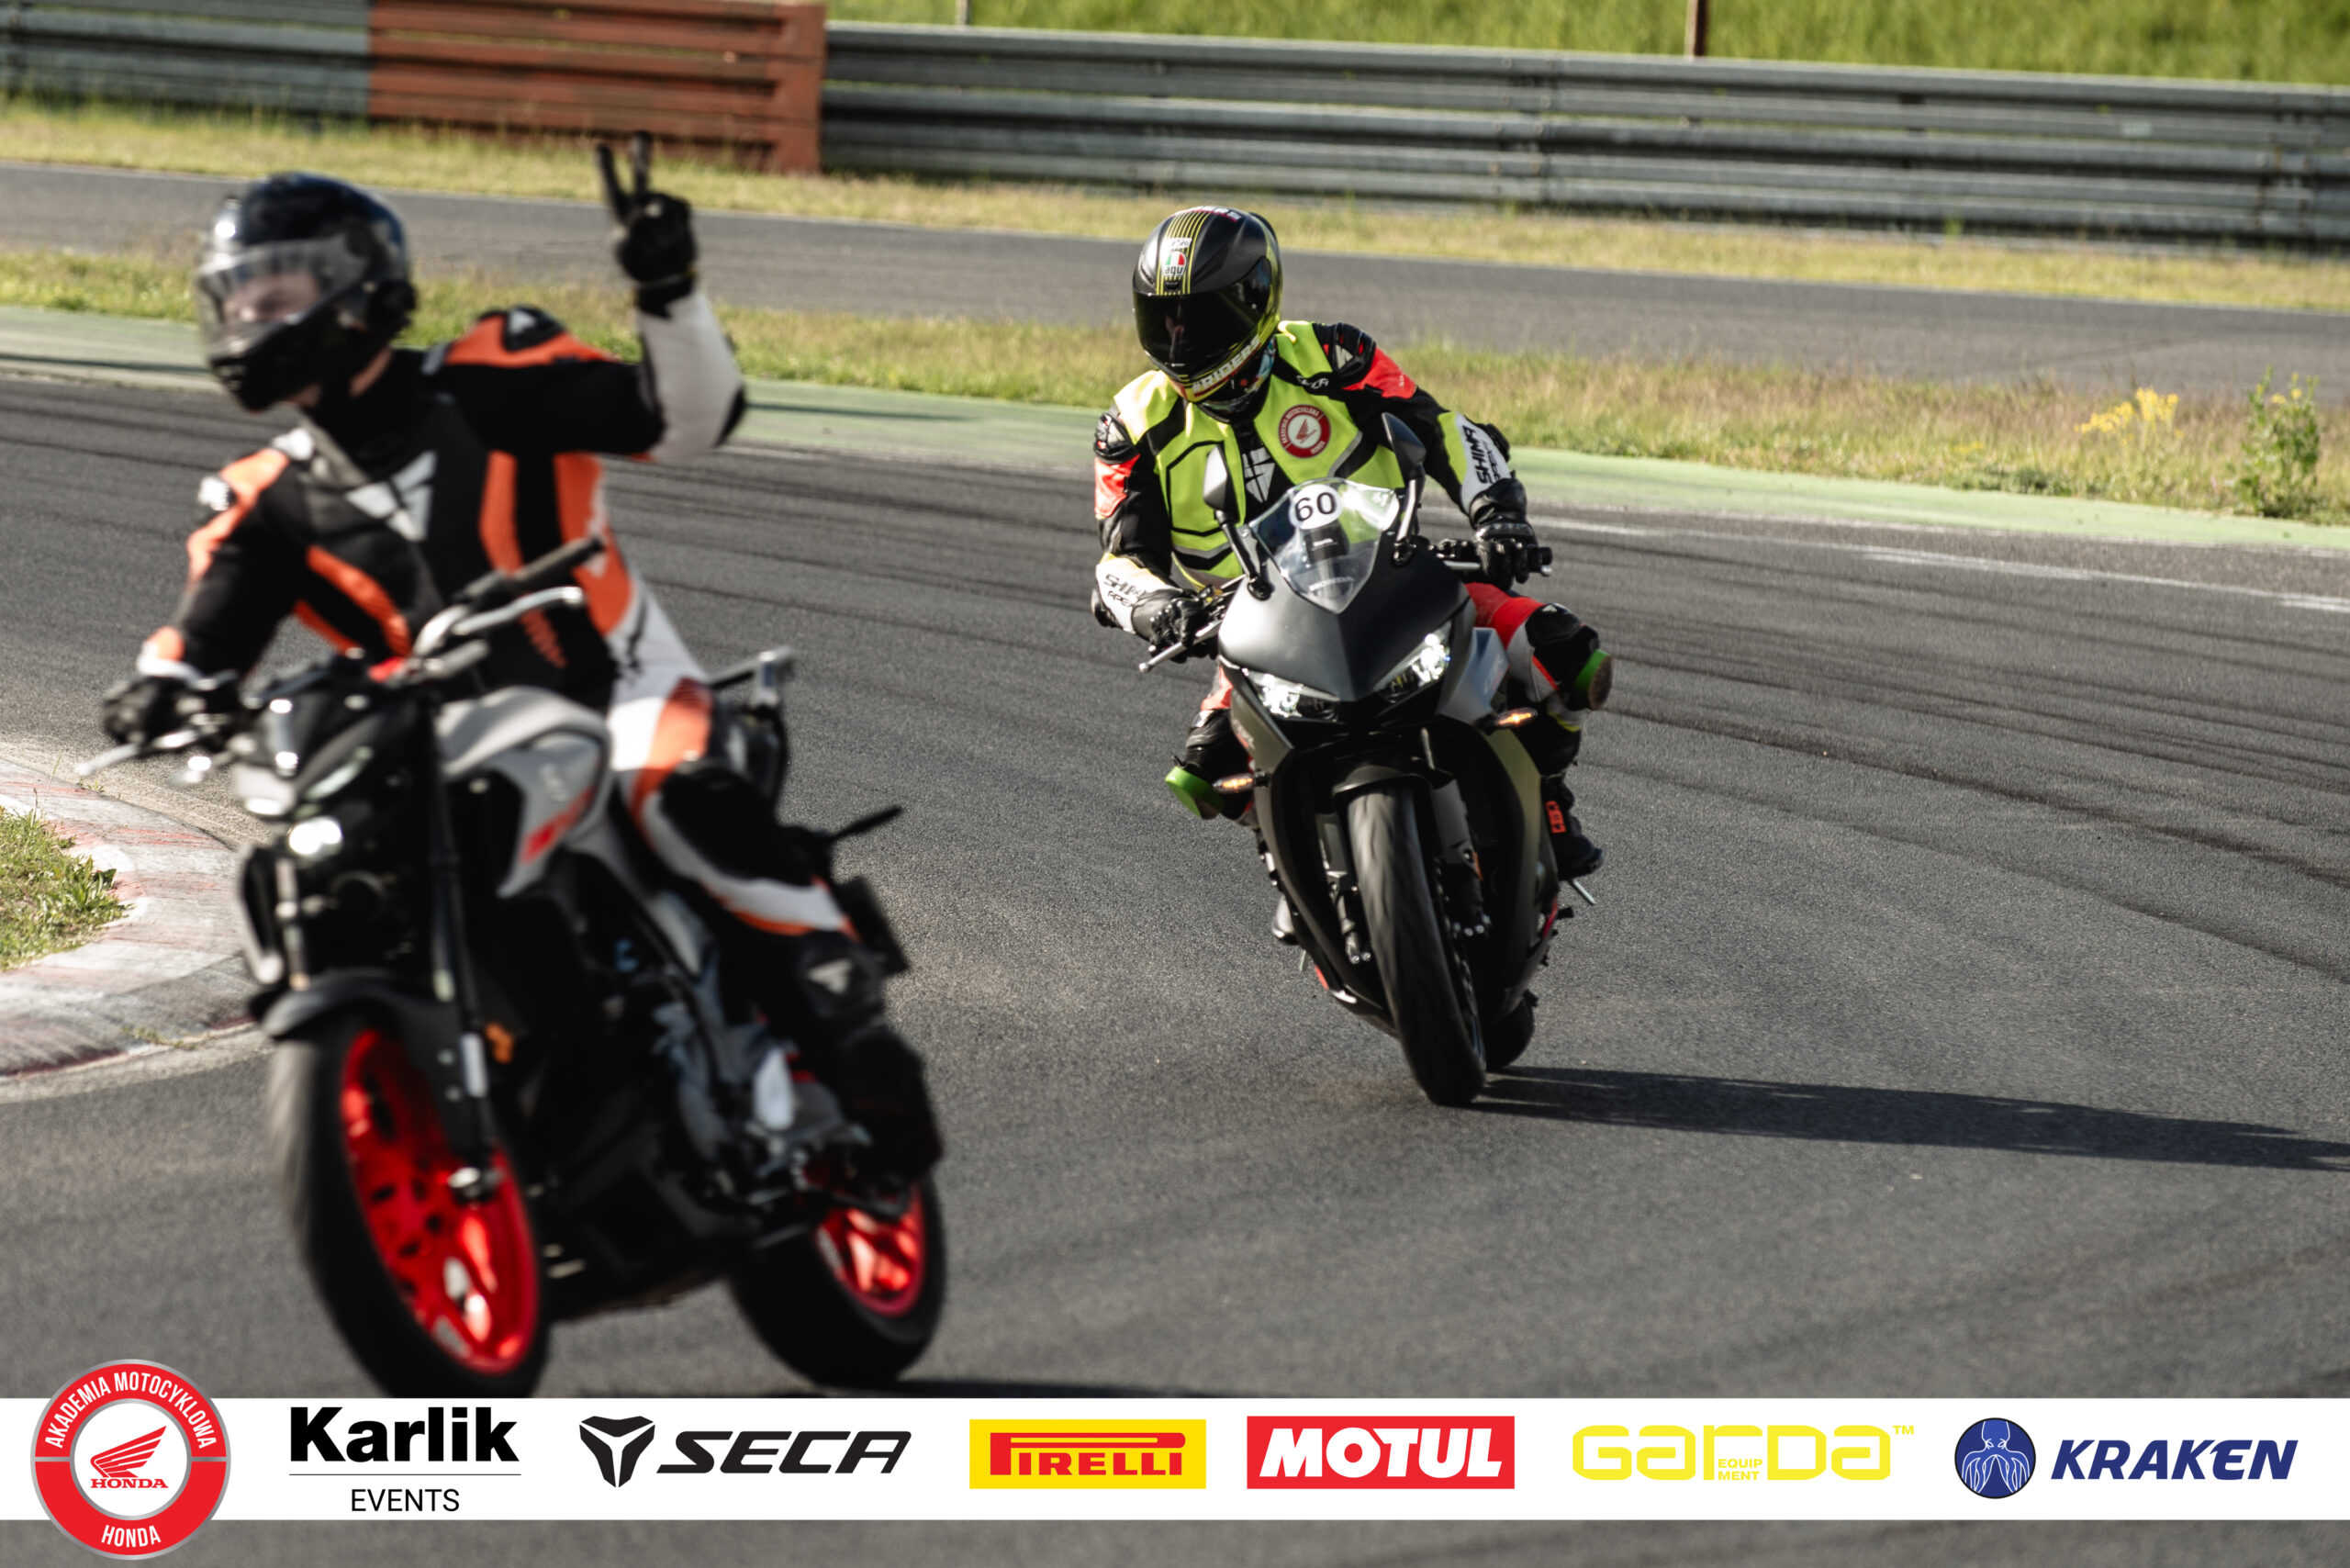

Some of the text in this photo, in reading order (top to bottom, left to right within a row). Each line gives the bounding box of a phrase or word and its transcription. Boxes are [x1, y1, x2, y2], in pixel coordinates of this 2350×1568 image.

[1165, 265, 1184, 276] agv
[1462, 425, 1494, 485] SHIMA
[1294, 491, 1337, 521] 60
[1308, 577, 1355, 592] HONDA
